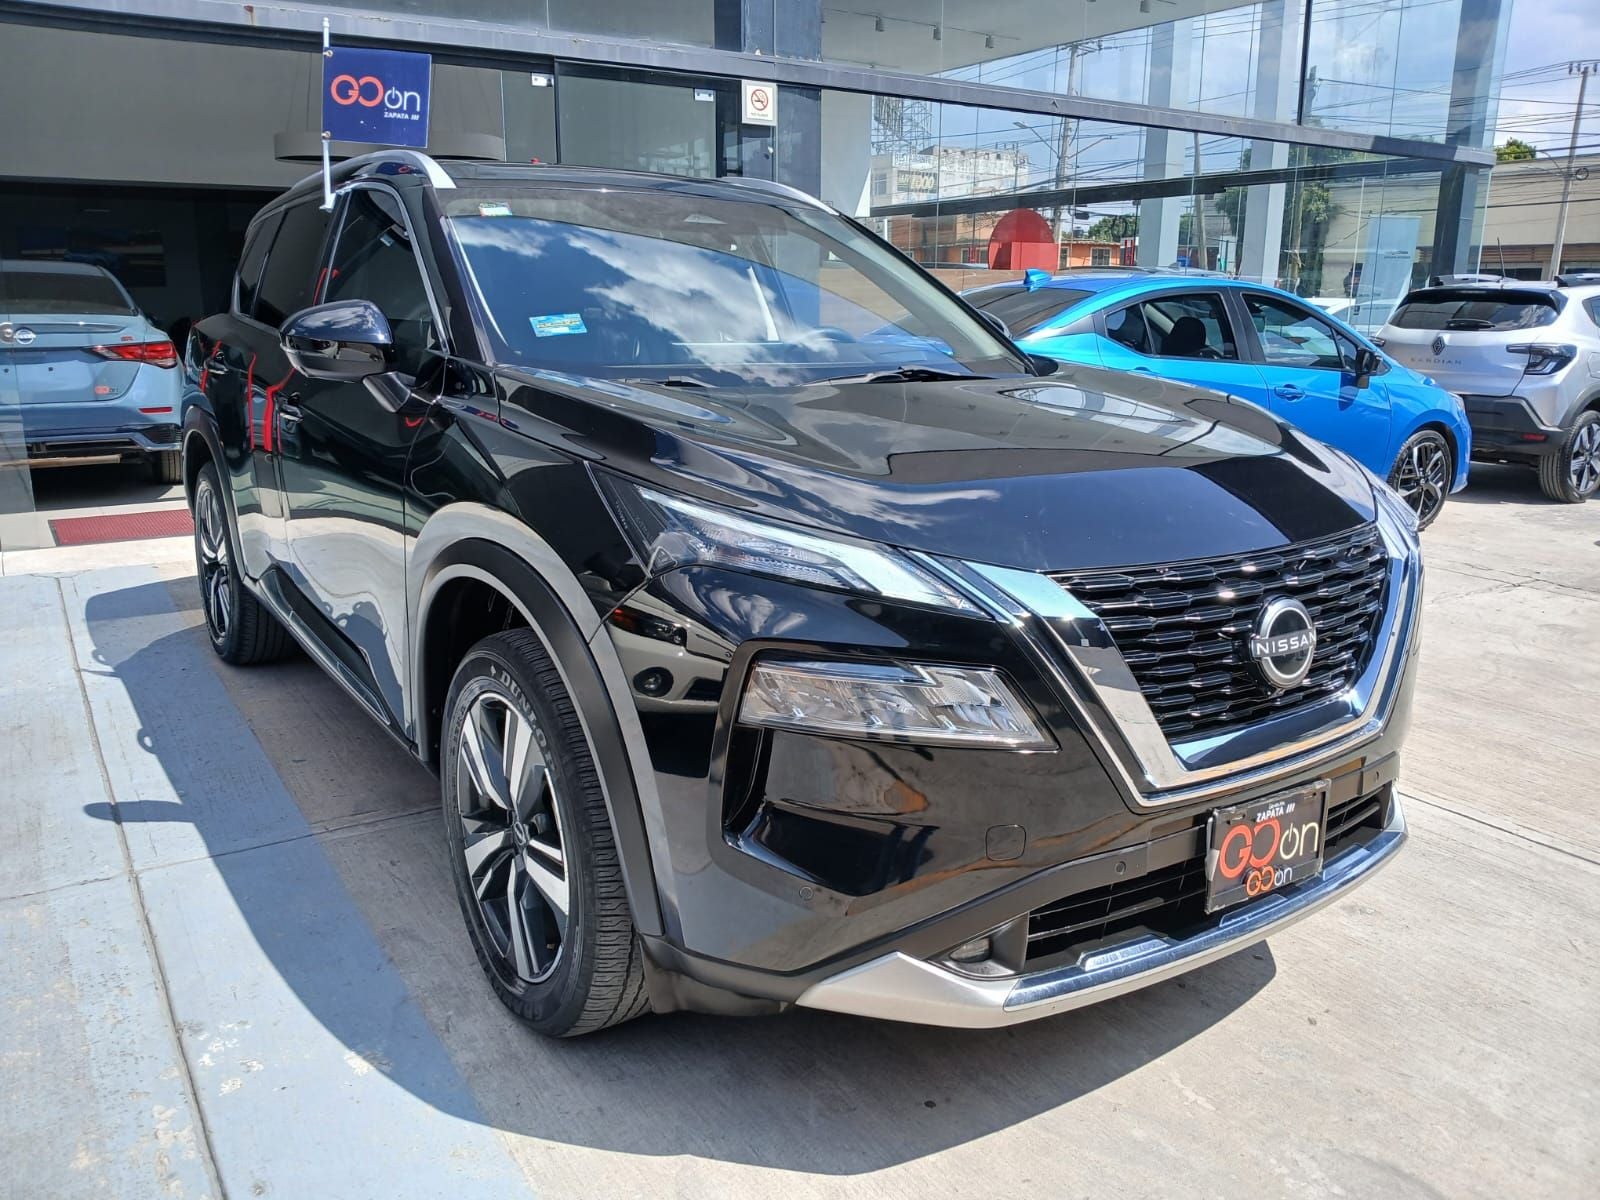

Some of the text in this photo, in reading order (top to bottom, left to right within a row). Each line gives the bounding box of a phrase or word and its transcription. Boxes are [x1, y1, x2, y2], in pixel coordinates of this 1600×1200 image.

[384, 111, 409, 120] ZAPATA
[1256, 632, 1316, 655] NISSAN
[501, 671, 556, 770] DUNLOP
[1257, 806, 1284, 822] ZAPATA
